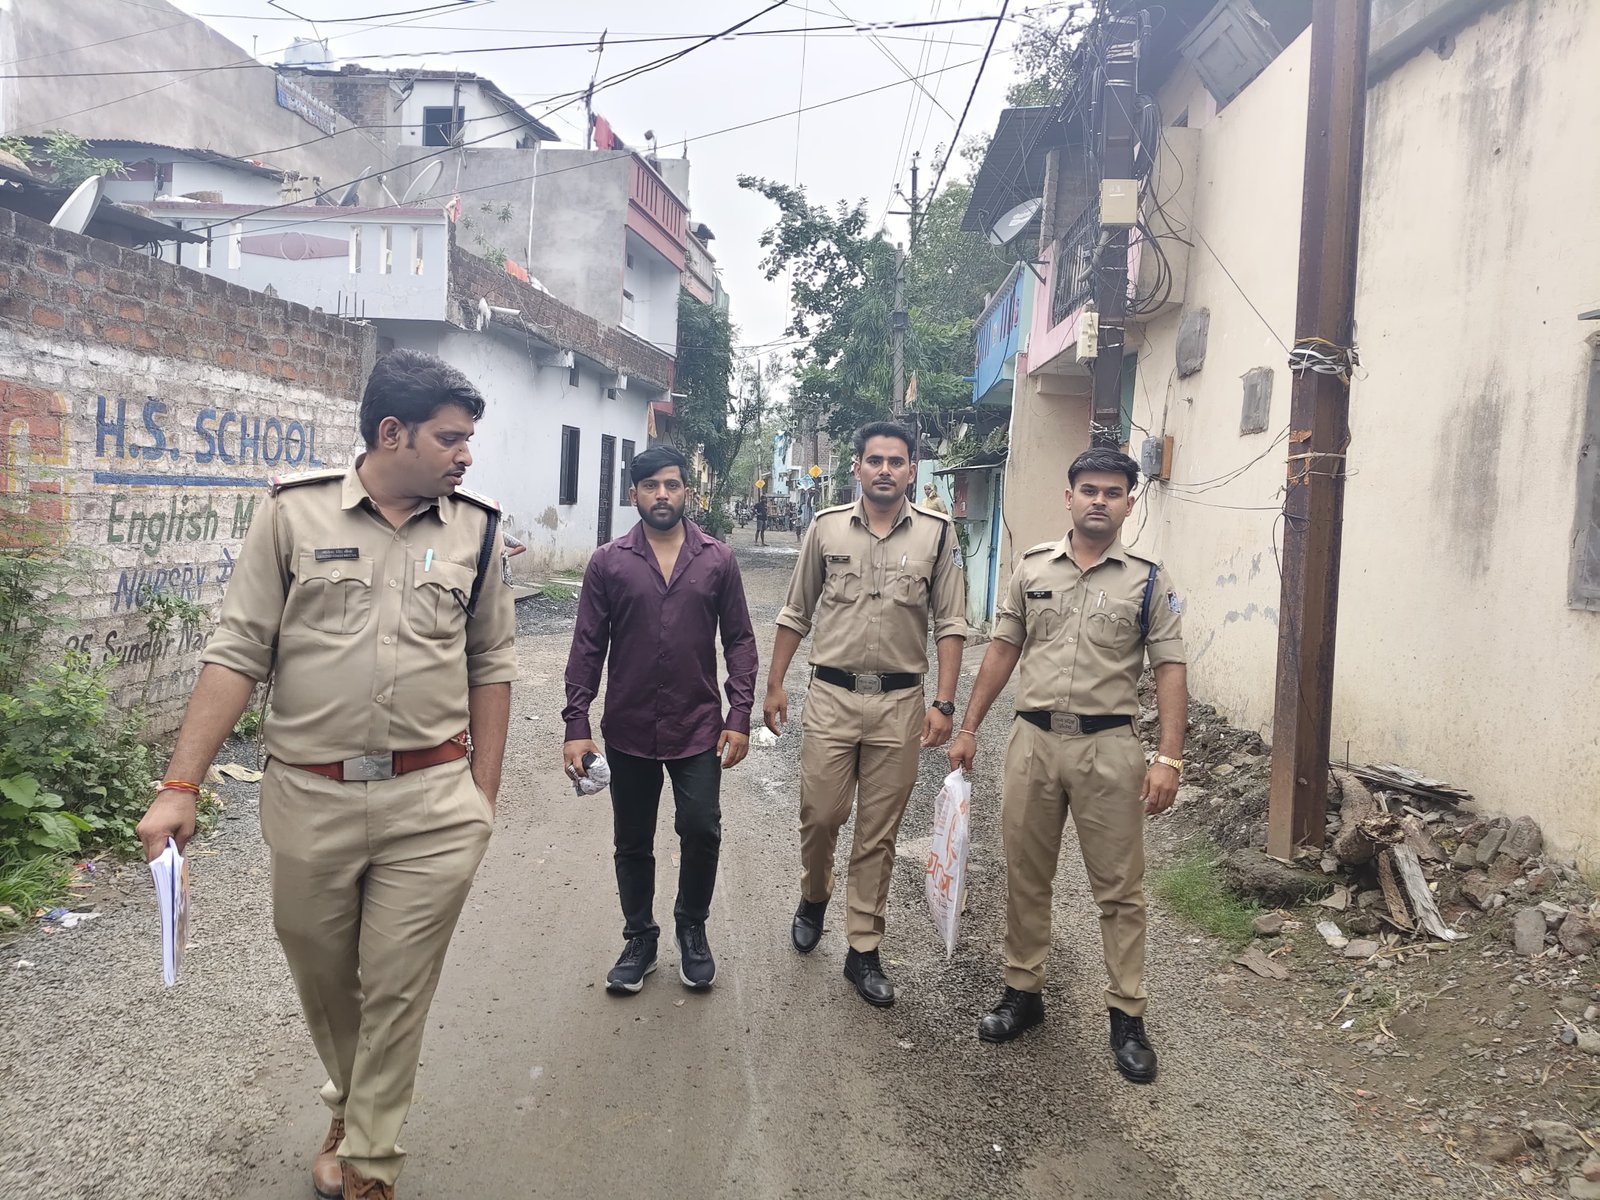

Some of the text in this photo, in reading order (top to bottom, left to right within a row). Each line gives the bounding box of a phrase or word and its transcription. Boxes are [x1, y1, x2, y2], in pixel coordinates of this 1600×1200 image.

[96, 394, 323, 468] H.S. SCHOOL
[107, 494, 219, 557] English
